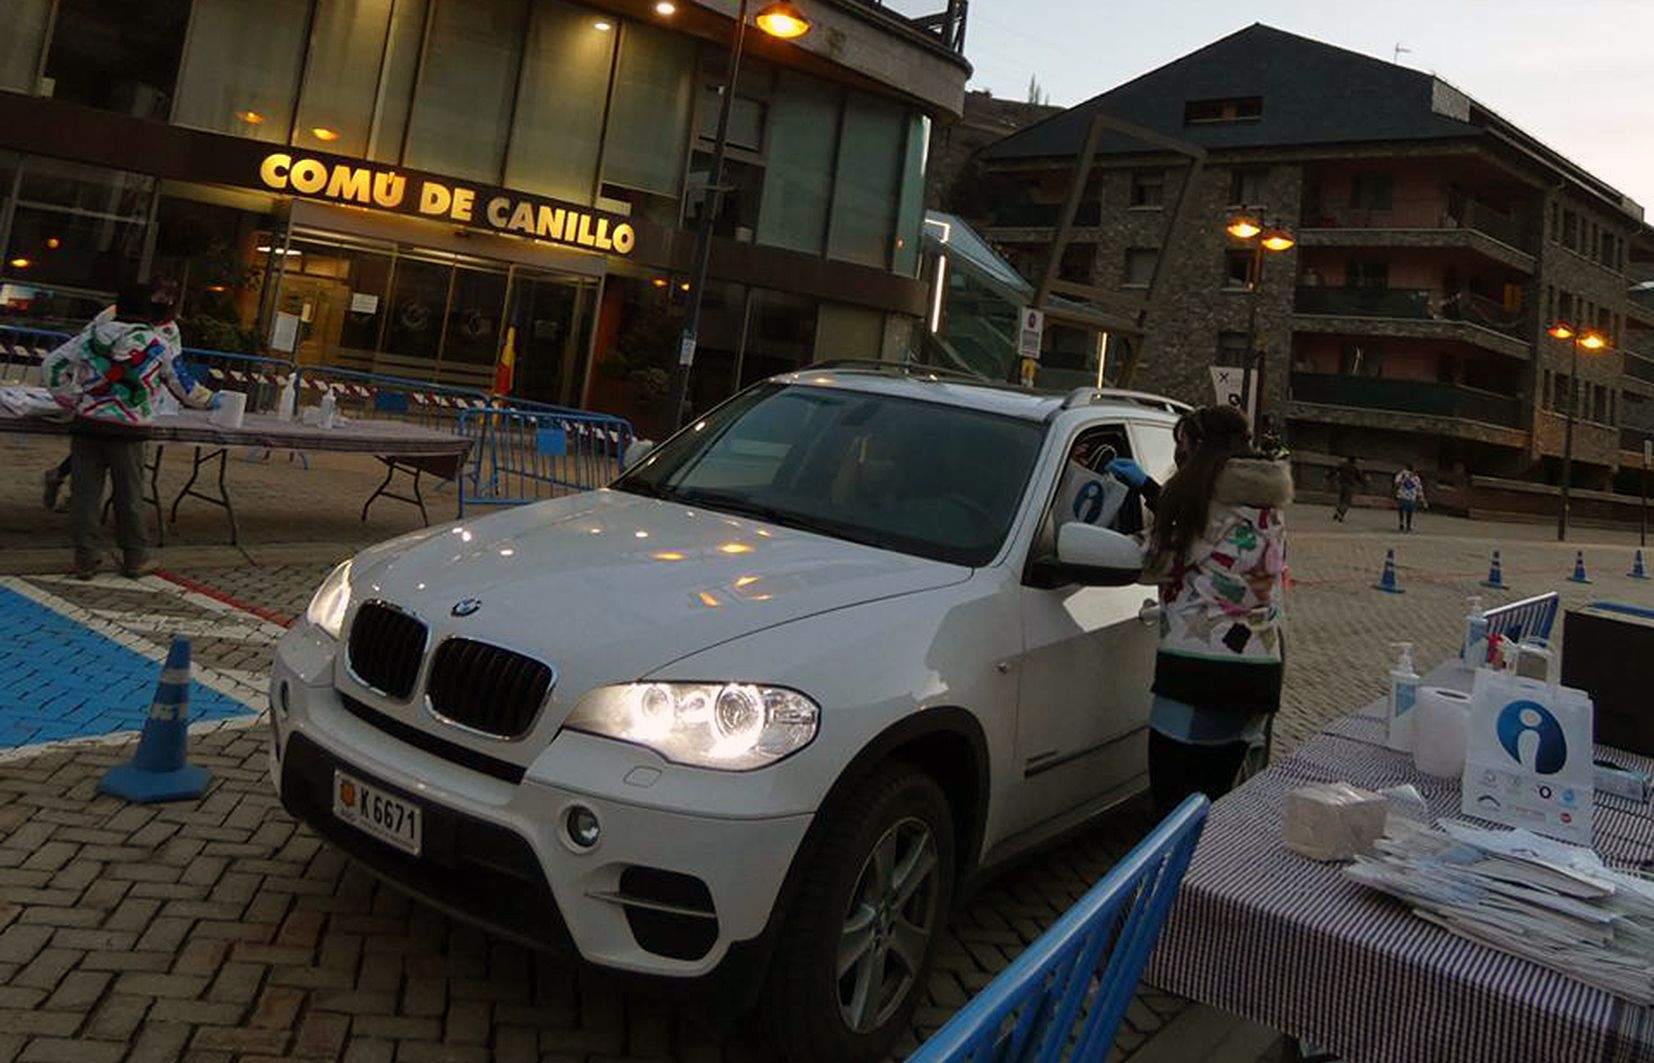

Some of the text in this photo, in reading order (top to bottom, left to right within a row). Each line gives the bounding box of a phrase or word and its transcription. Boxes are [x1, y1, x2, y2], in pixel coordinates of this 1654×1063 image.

[260, 153, 635, 254] COMÚ DE CANILLO
